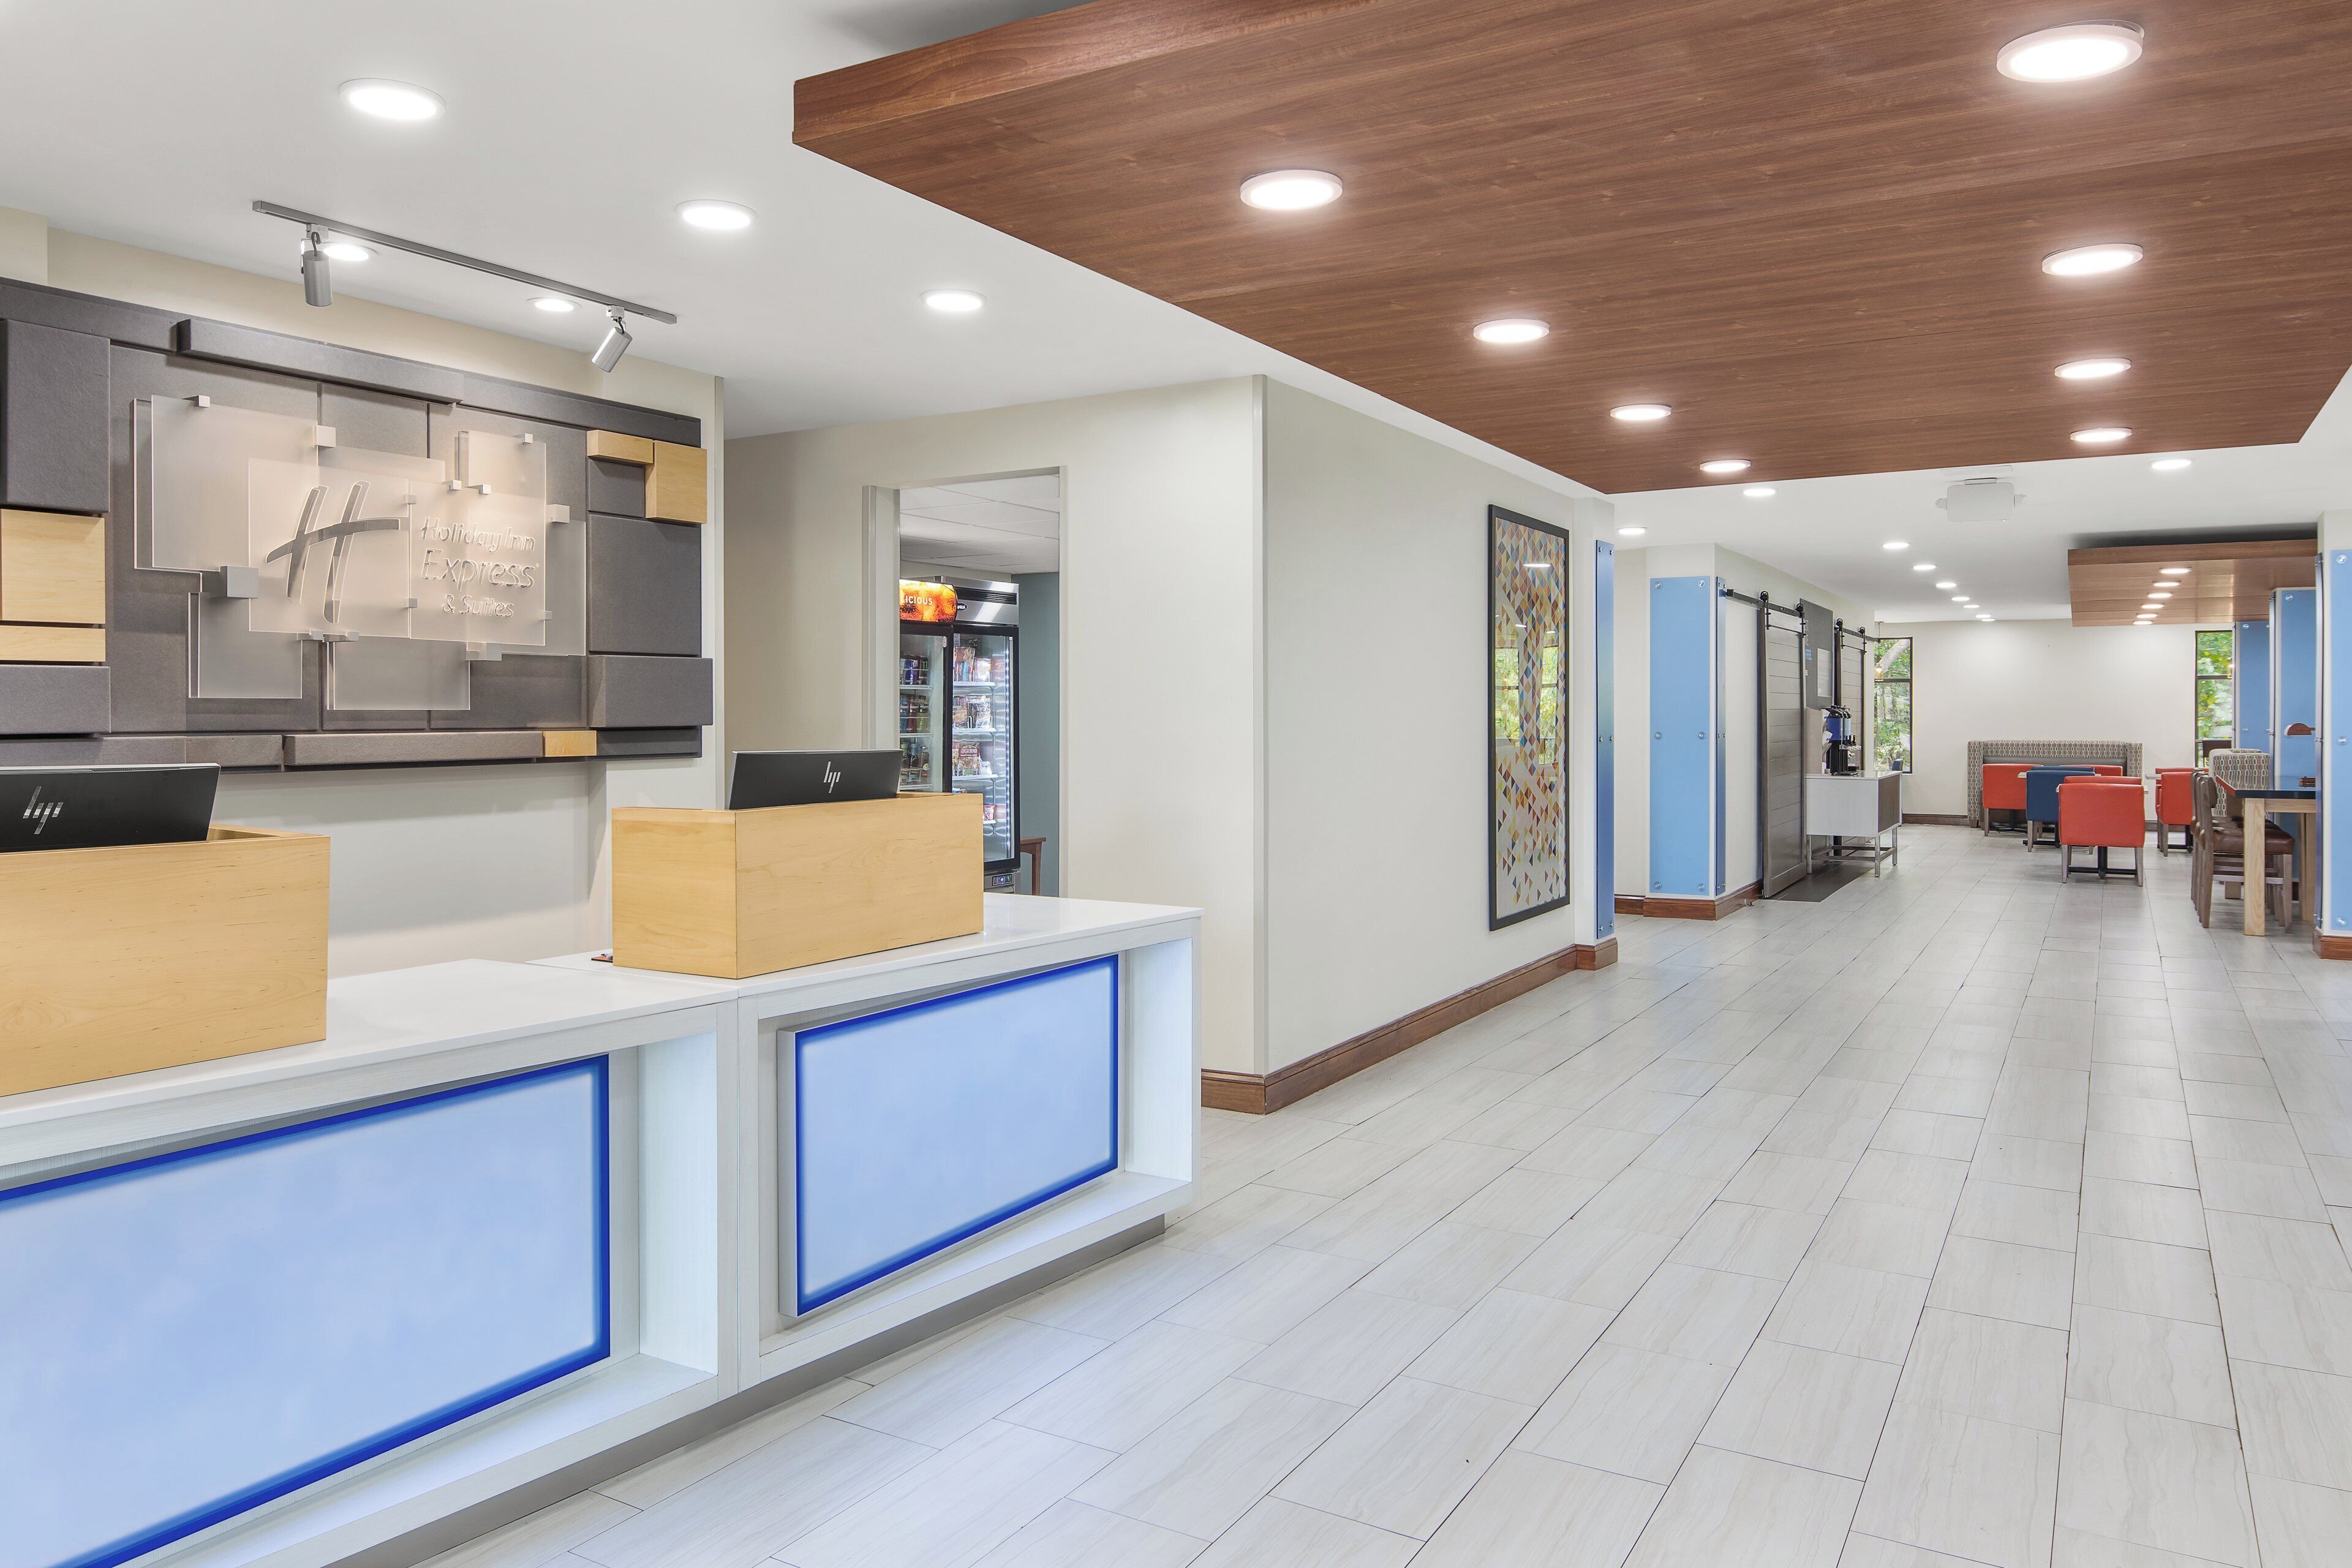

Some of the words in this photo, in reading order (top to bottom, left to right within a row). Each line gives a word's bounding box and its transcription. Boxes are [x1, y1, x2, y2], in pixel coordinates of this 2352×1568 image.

[421, 516, 502, 552] Holiday
[505, 527, 535, 551] Inn
[421, 548, 535, 592] Express
[442, 594, 455, 614] &
[459, 595, 514, 618] Suites
[823, 761, 840, 794] hp
[22, 786, 64, 835] hp
